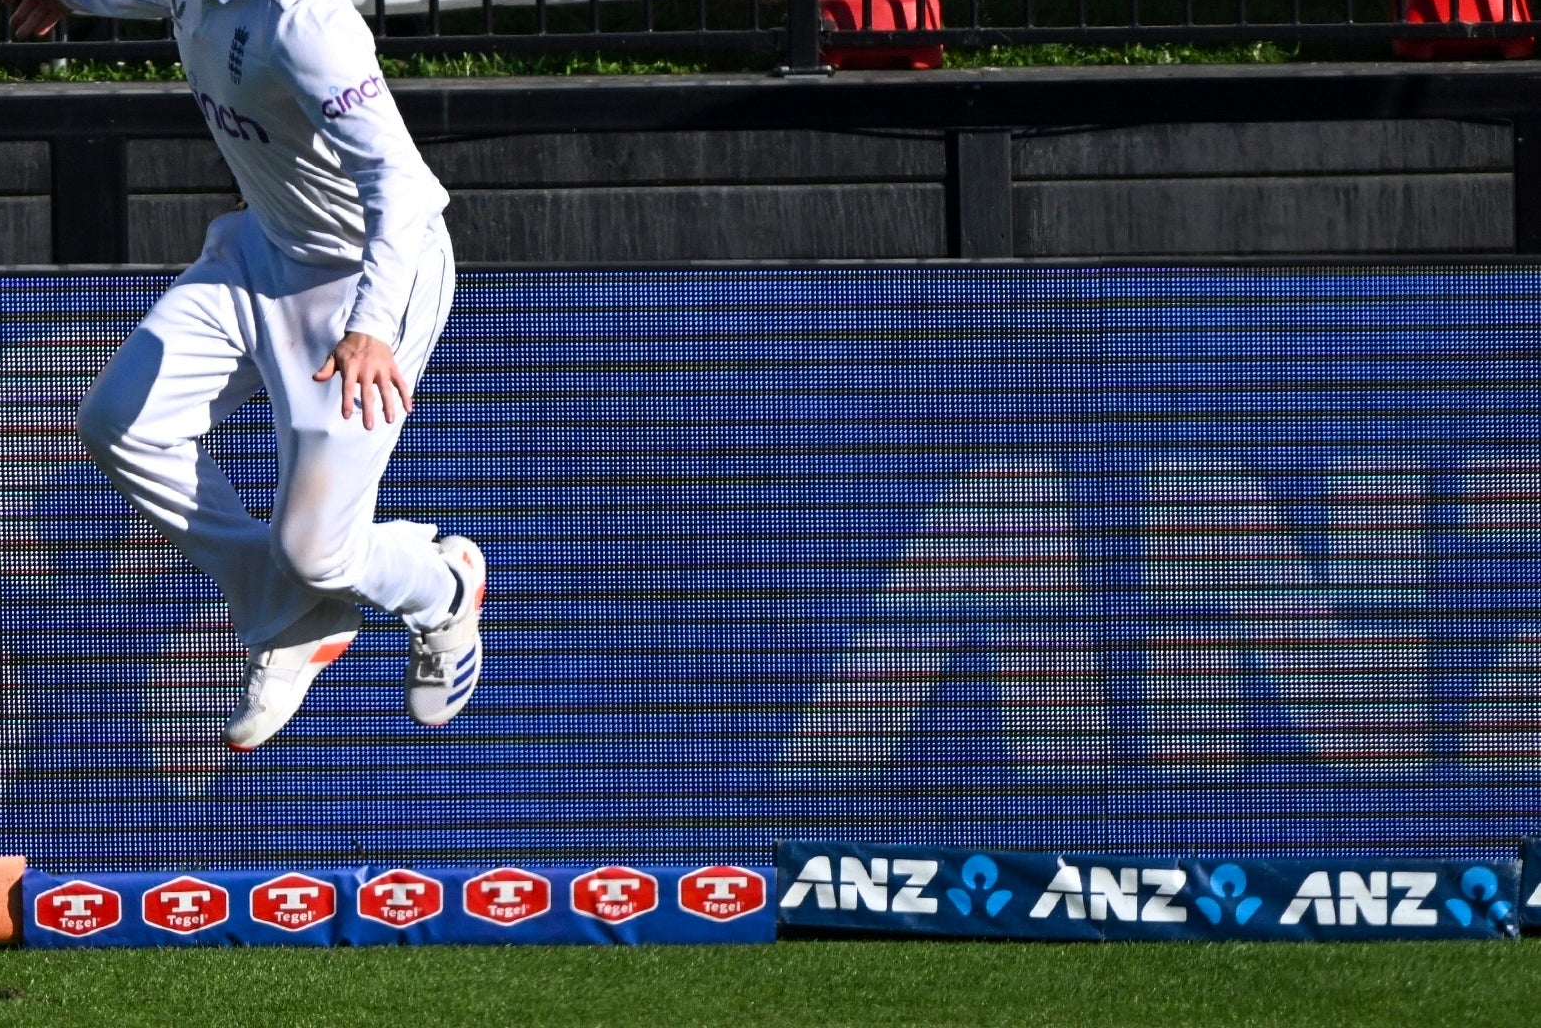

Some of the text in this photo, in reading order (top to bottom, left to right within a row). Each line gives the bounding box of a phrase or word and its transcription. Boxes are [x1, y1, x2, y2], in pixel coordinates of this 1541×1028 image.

[322, 74, 387, 119] cinch
[773, 456, 1541, 776] AN
[780, 856, 937, 913] ANZ
[1029, 866, 1187, 922] ANZ
[1279, 871, 1438, 927] ANZ
[381, 907, 418, 920] Tegel
[488, 904, 526, 917] Tegel
[596, 902, 633, 917] Tegel
[703, 901, 741, 913] Tegel
[59, 917, 98, 930] Tegel
[166, 914, 205, 926] Tegel
[274, 910, 313, 924] Tegel
